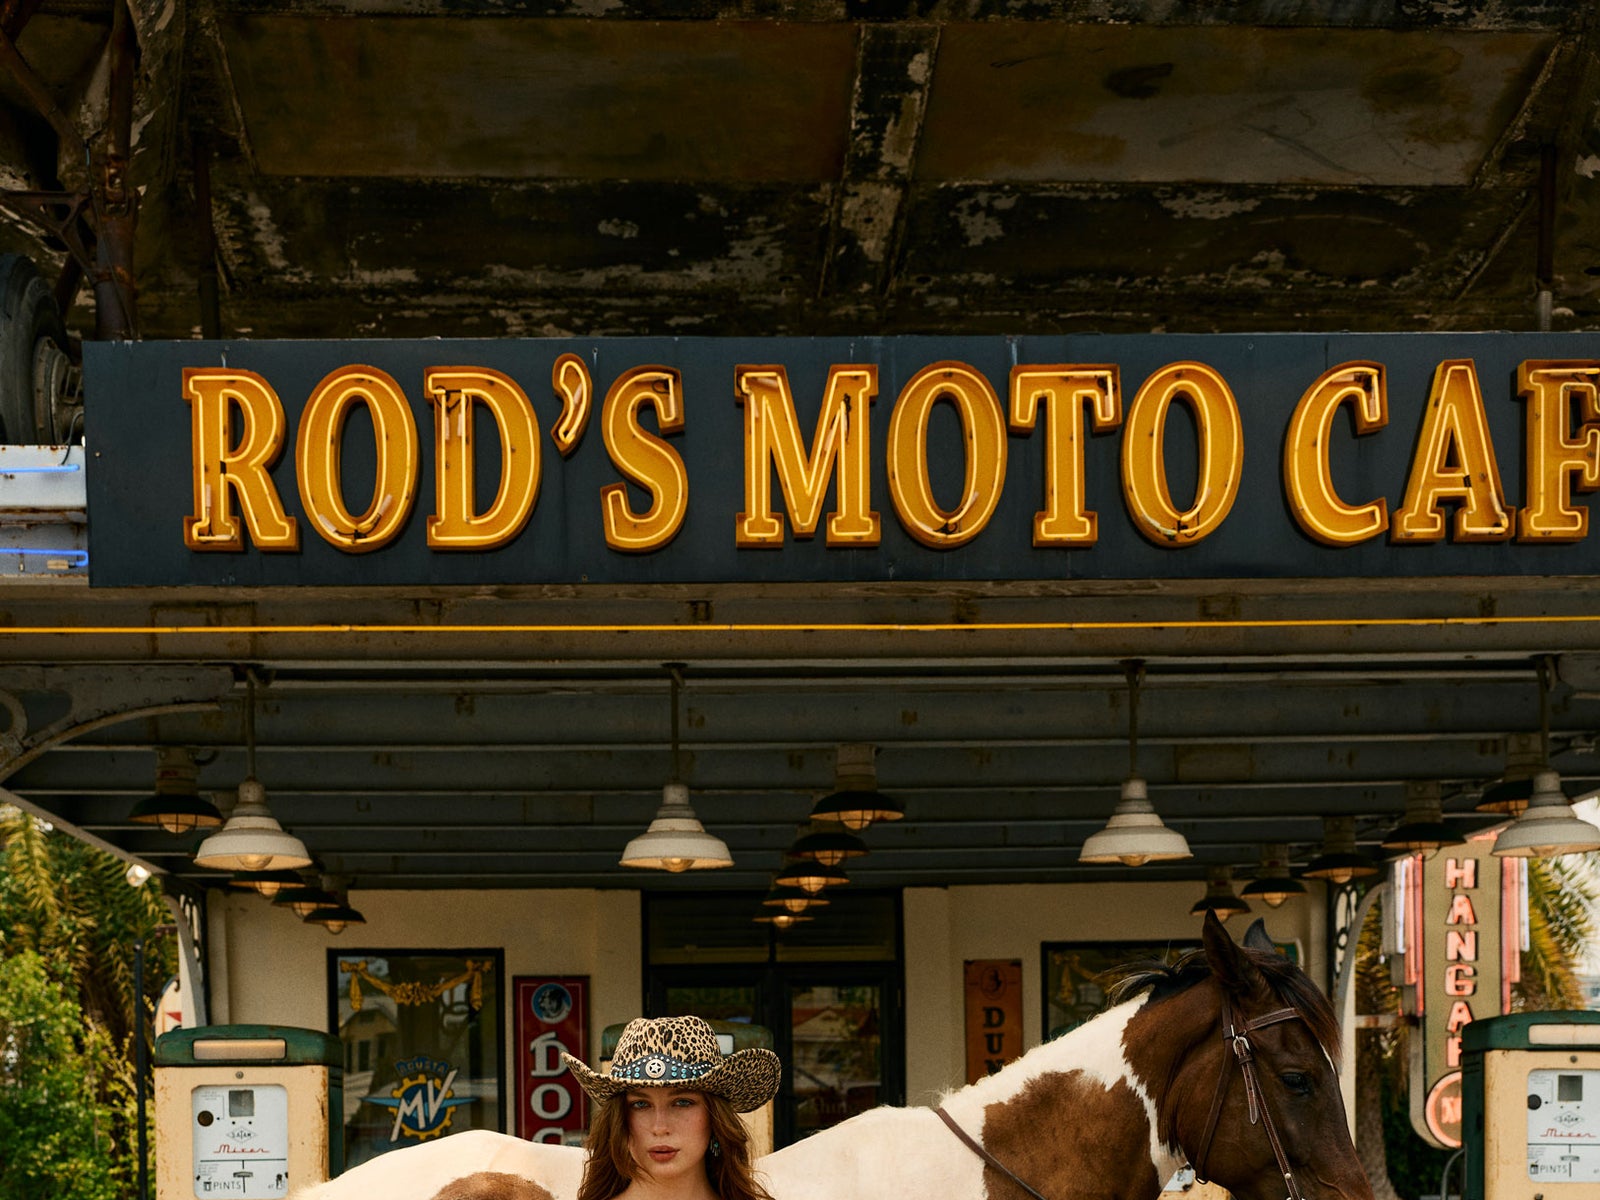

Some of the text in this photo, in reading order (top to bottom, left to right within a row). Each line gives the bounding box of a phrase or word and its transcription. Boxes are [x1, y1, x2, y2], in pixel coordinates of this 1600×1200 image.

[182, 353, 690, 554] ROD'S
[735, 359, 1244, 550] MOTO
[389, 1067, 459, 1143] MV
[213, 1180, 242, 1191] PINTS
[1539, 1163, 1568, 1174] PINTS
